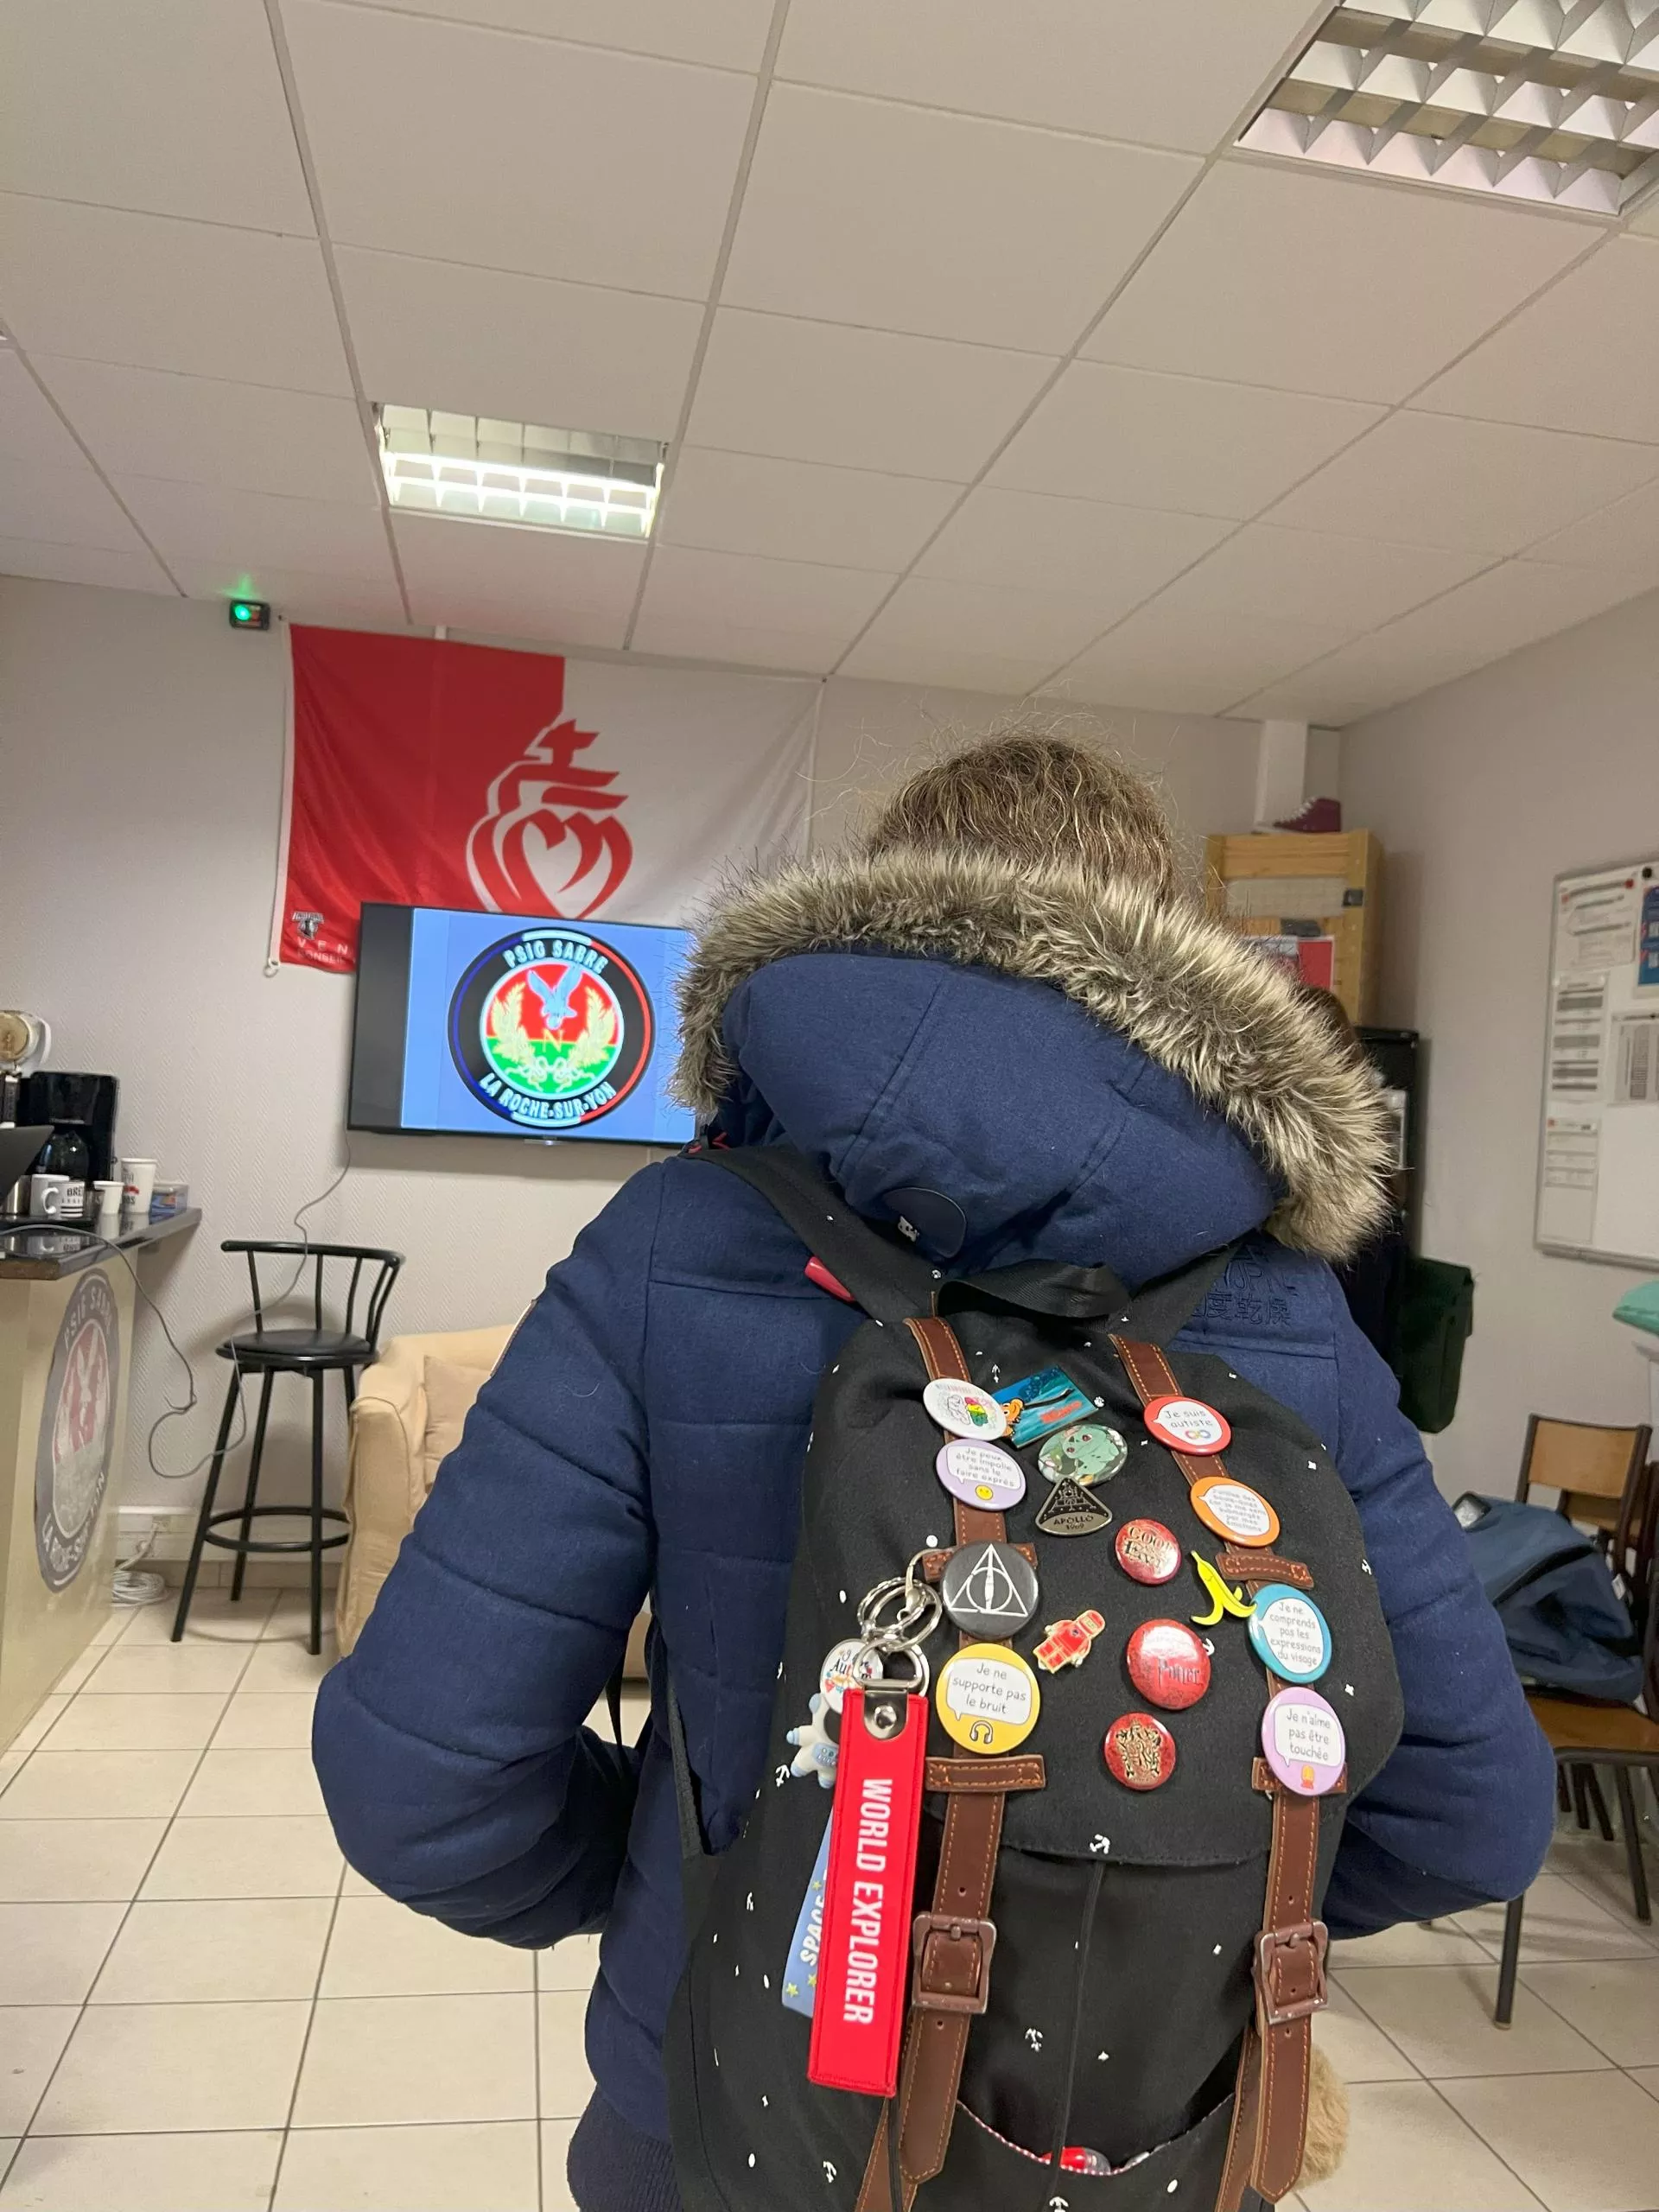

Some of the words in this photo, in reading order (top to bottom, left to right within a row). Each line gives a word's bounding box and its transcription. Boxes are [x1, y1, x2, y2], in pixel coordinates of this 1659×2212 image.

[552, 939, 608, 974] SABRE
[480, 1072, 501, 1096] LA
[499, 1081, 617, 1120] ROCHE-SUR-YON
[1164, 1409, 1180, 1419] Je
[1184, 1408, 1206, 1418] suis
[1170, 1419, 1213, 1428] autiste
[957, 1467, 978, 1478] faire
[1054, 1515, 1094, 1525] APOLLO
[1279, 1602, 1291, 1612] Je
[1269, 1613, 1316, 1629] comprends
[1280, 1628, 1294, 1638] pas
[1297, 1628, 1310, 1639] les
[1271, 1638, 1321, 1654] expressions
[1291, 1653, 1318, 1668] visage
[976, 1662, 989, 1676] Je
[994, 1669, 1007, 1680] ne
[952, 1677, 1002, 1695] supporte
[1007, 1690, 1027, 1701] pas
[966, 1694, 976, 1707] le
[980, 1697, 1007, 1713] bruit
[1287, 1708, 1299, 1722] Je
[1302, 1711, 1332, 1729] n'aime
[1289, 1728, 1306, 1739] pas
[1309, 1730, 1329, 1745] être
[1290, 1741, 1329, 1761] touchée
[856, 1778, 893, 1872] WORLD
[843, 1881, 884, 2025] EXPLORER
